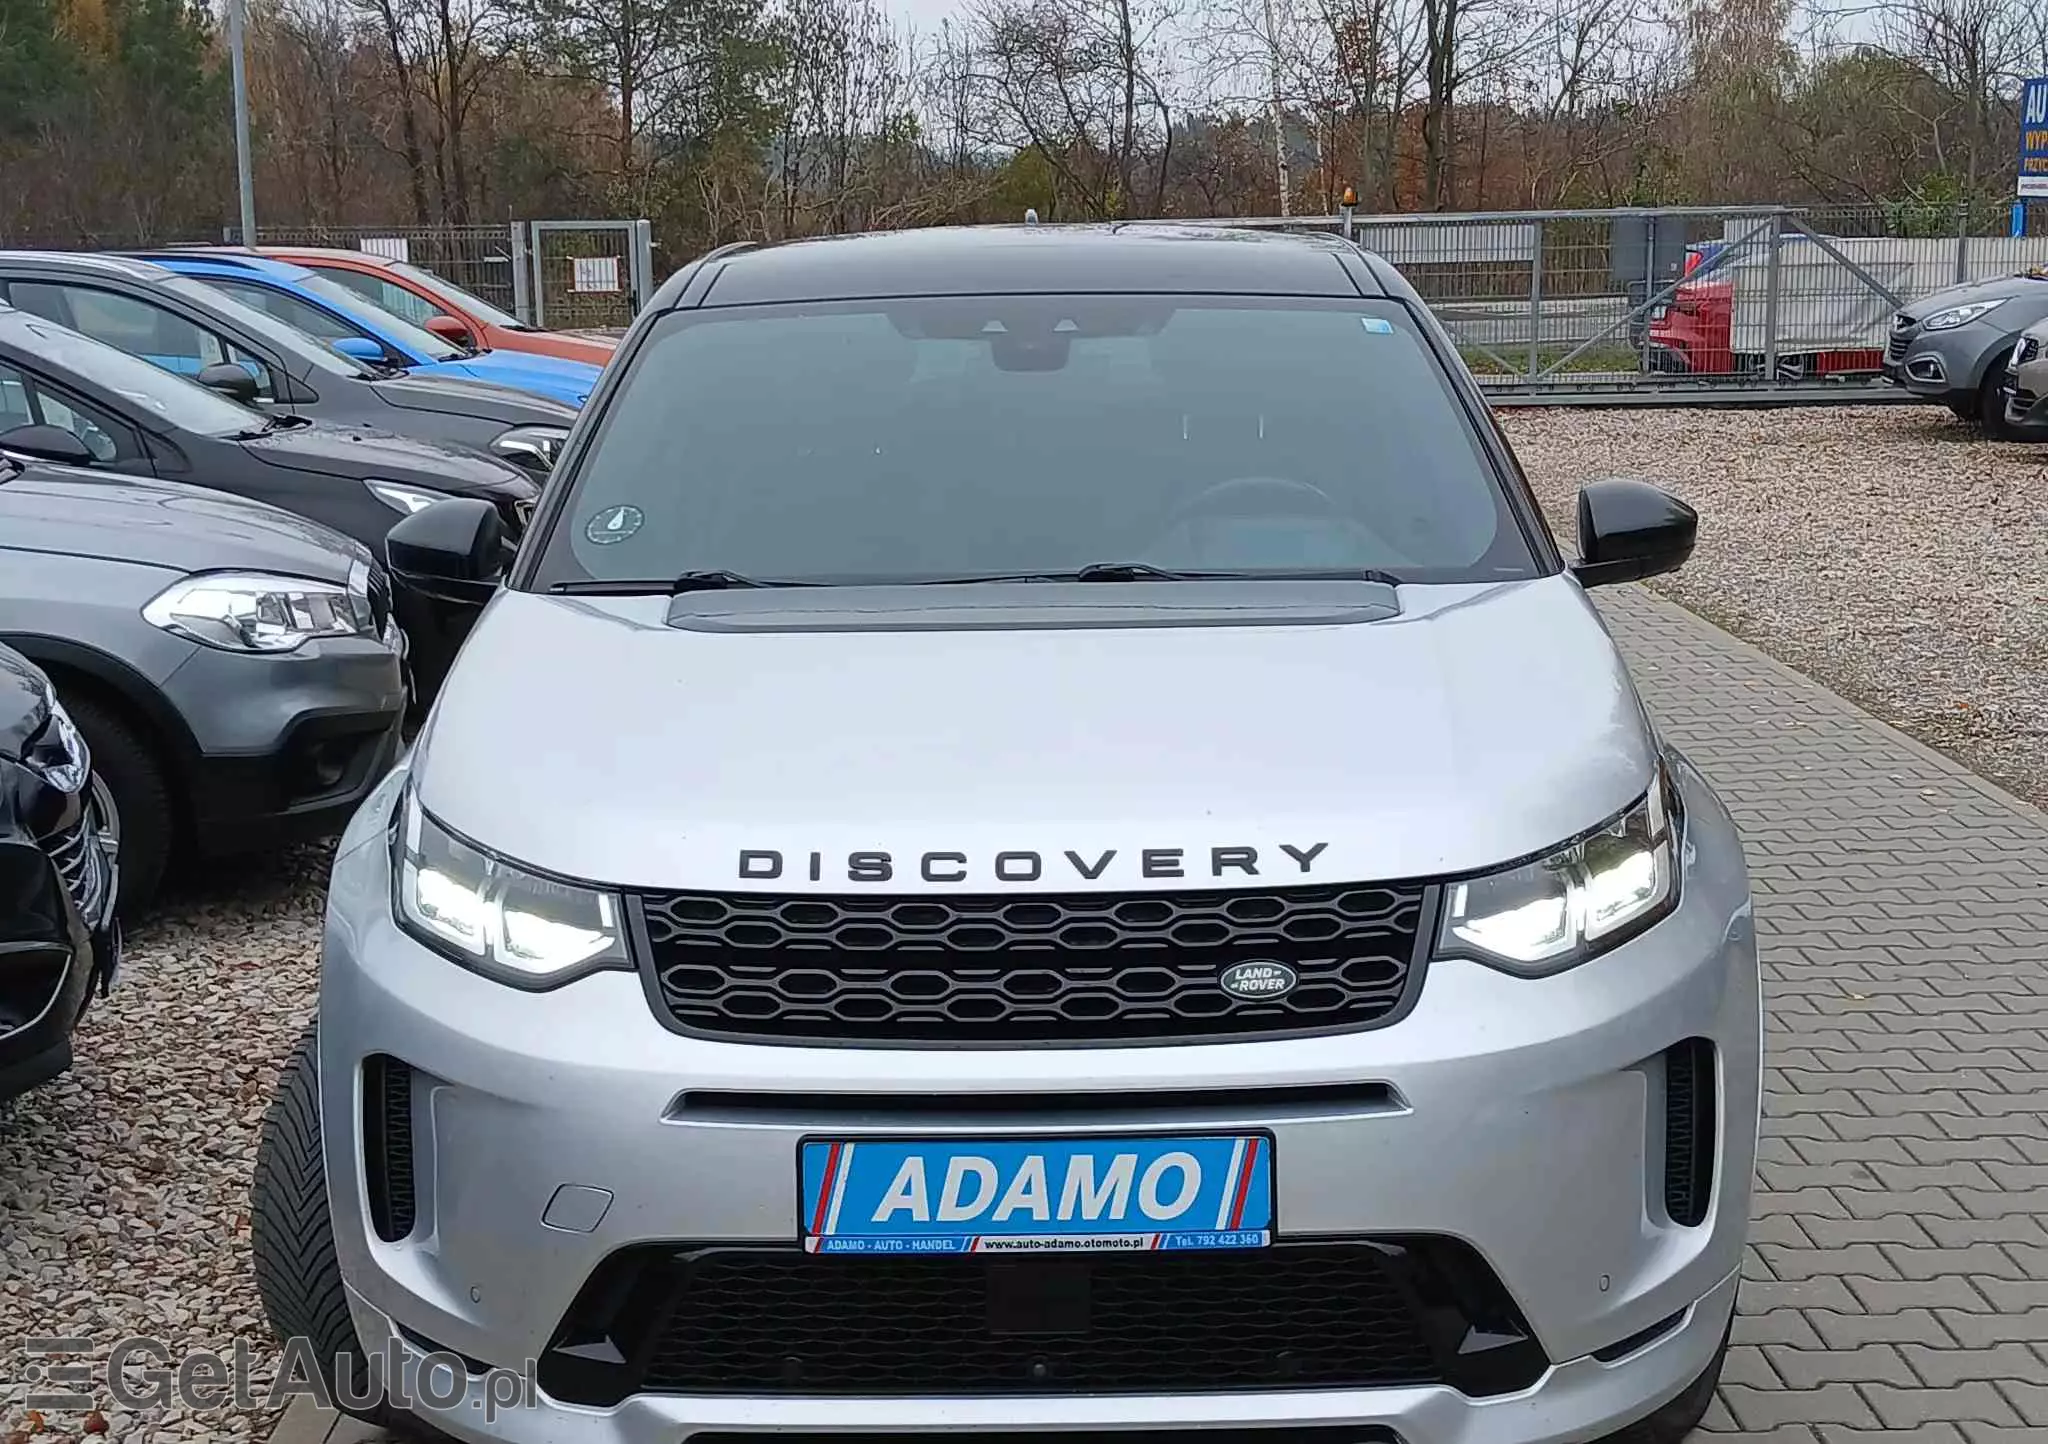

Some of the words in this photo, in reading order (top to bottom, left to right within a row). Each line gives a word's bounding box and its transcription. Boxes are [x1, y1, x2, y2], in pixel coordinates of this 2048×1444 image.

[739, 842, 1329, 882] DISCOVERY
[871, 1151, 1202, 1223] ADAMO
[826, 1239, 865, 1250] ADAMO
[873, 1239, 903, 1250] AUTO
[912, 1239, 956, 1250] HANDEL
[984, 1237, 1144, 1249] www.auto-adamo.otomoto.pl
[1196, 1235, 1216, 1246] 792
[1217, 1234, 1237, 1245] 422
